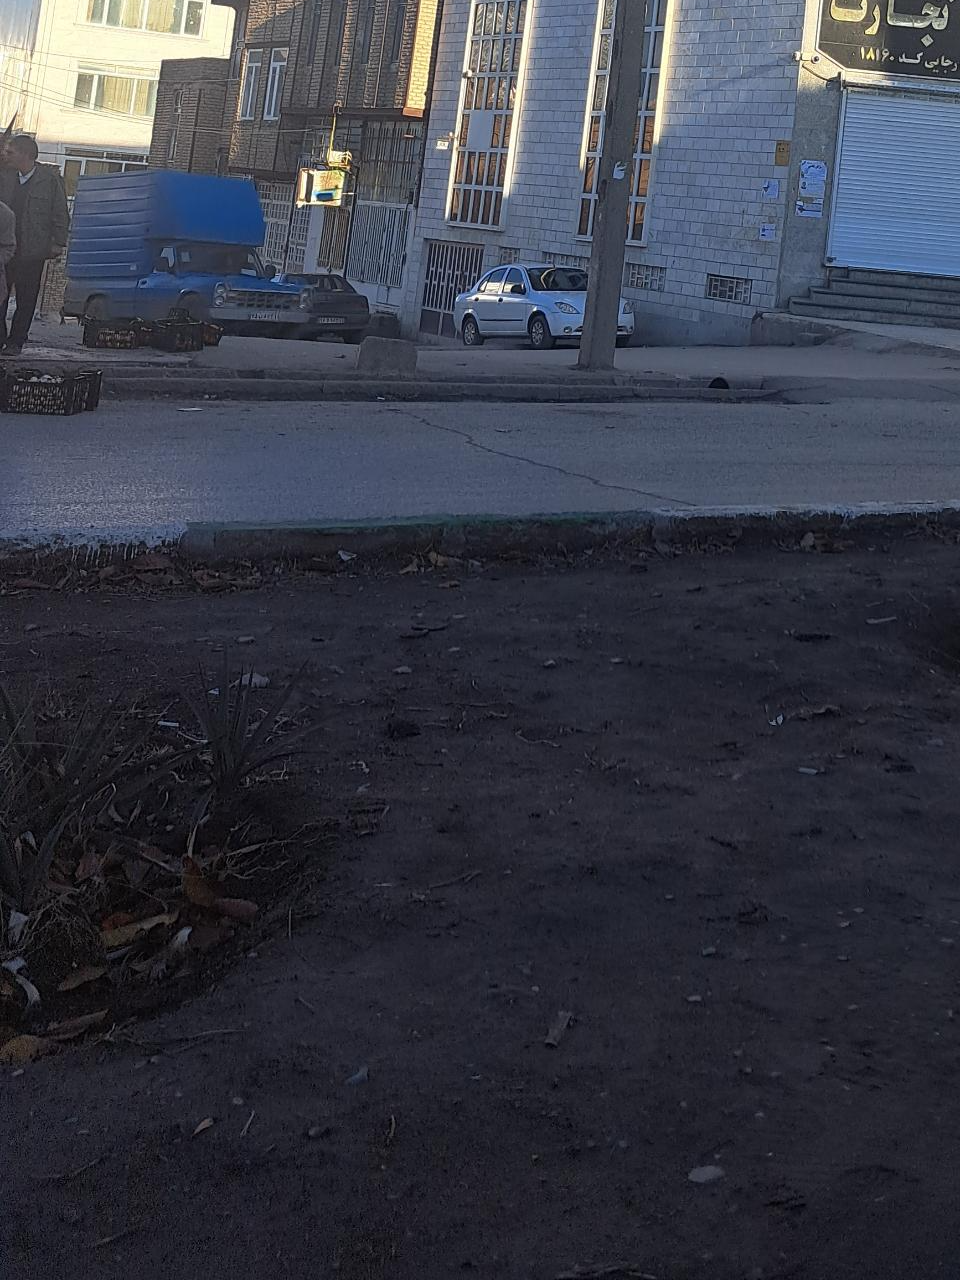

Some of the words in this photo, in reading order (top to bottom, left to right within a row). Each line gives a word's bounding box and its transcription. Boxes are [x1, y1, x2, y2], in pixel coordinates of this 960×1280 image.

[860, 46, 895, 62] ۱۸۱۶۰
[898, 51, 924, 64] کد
[924, 55, 958, 74] رجایی
